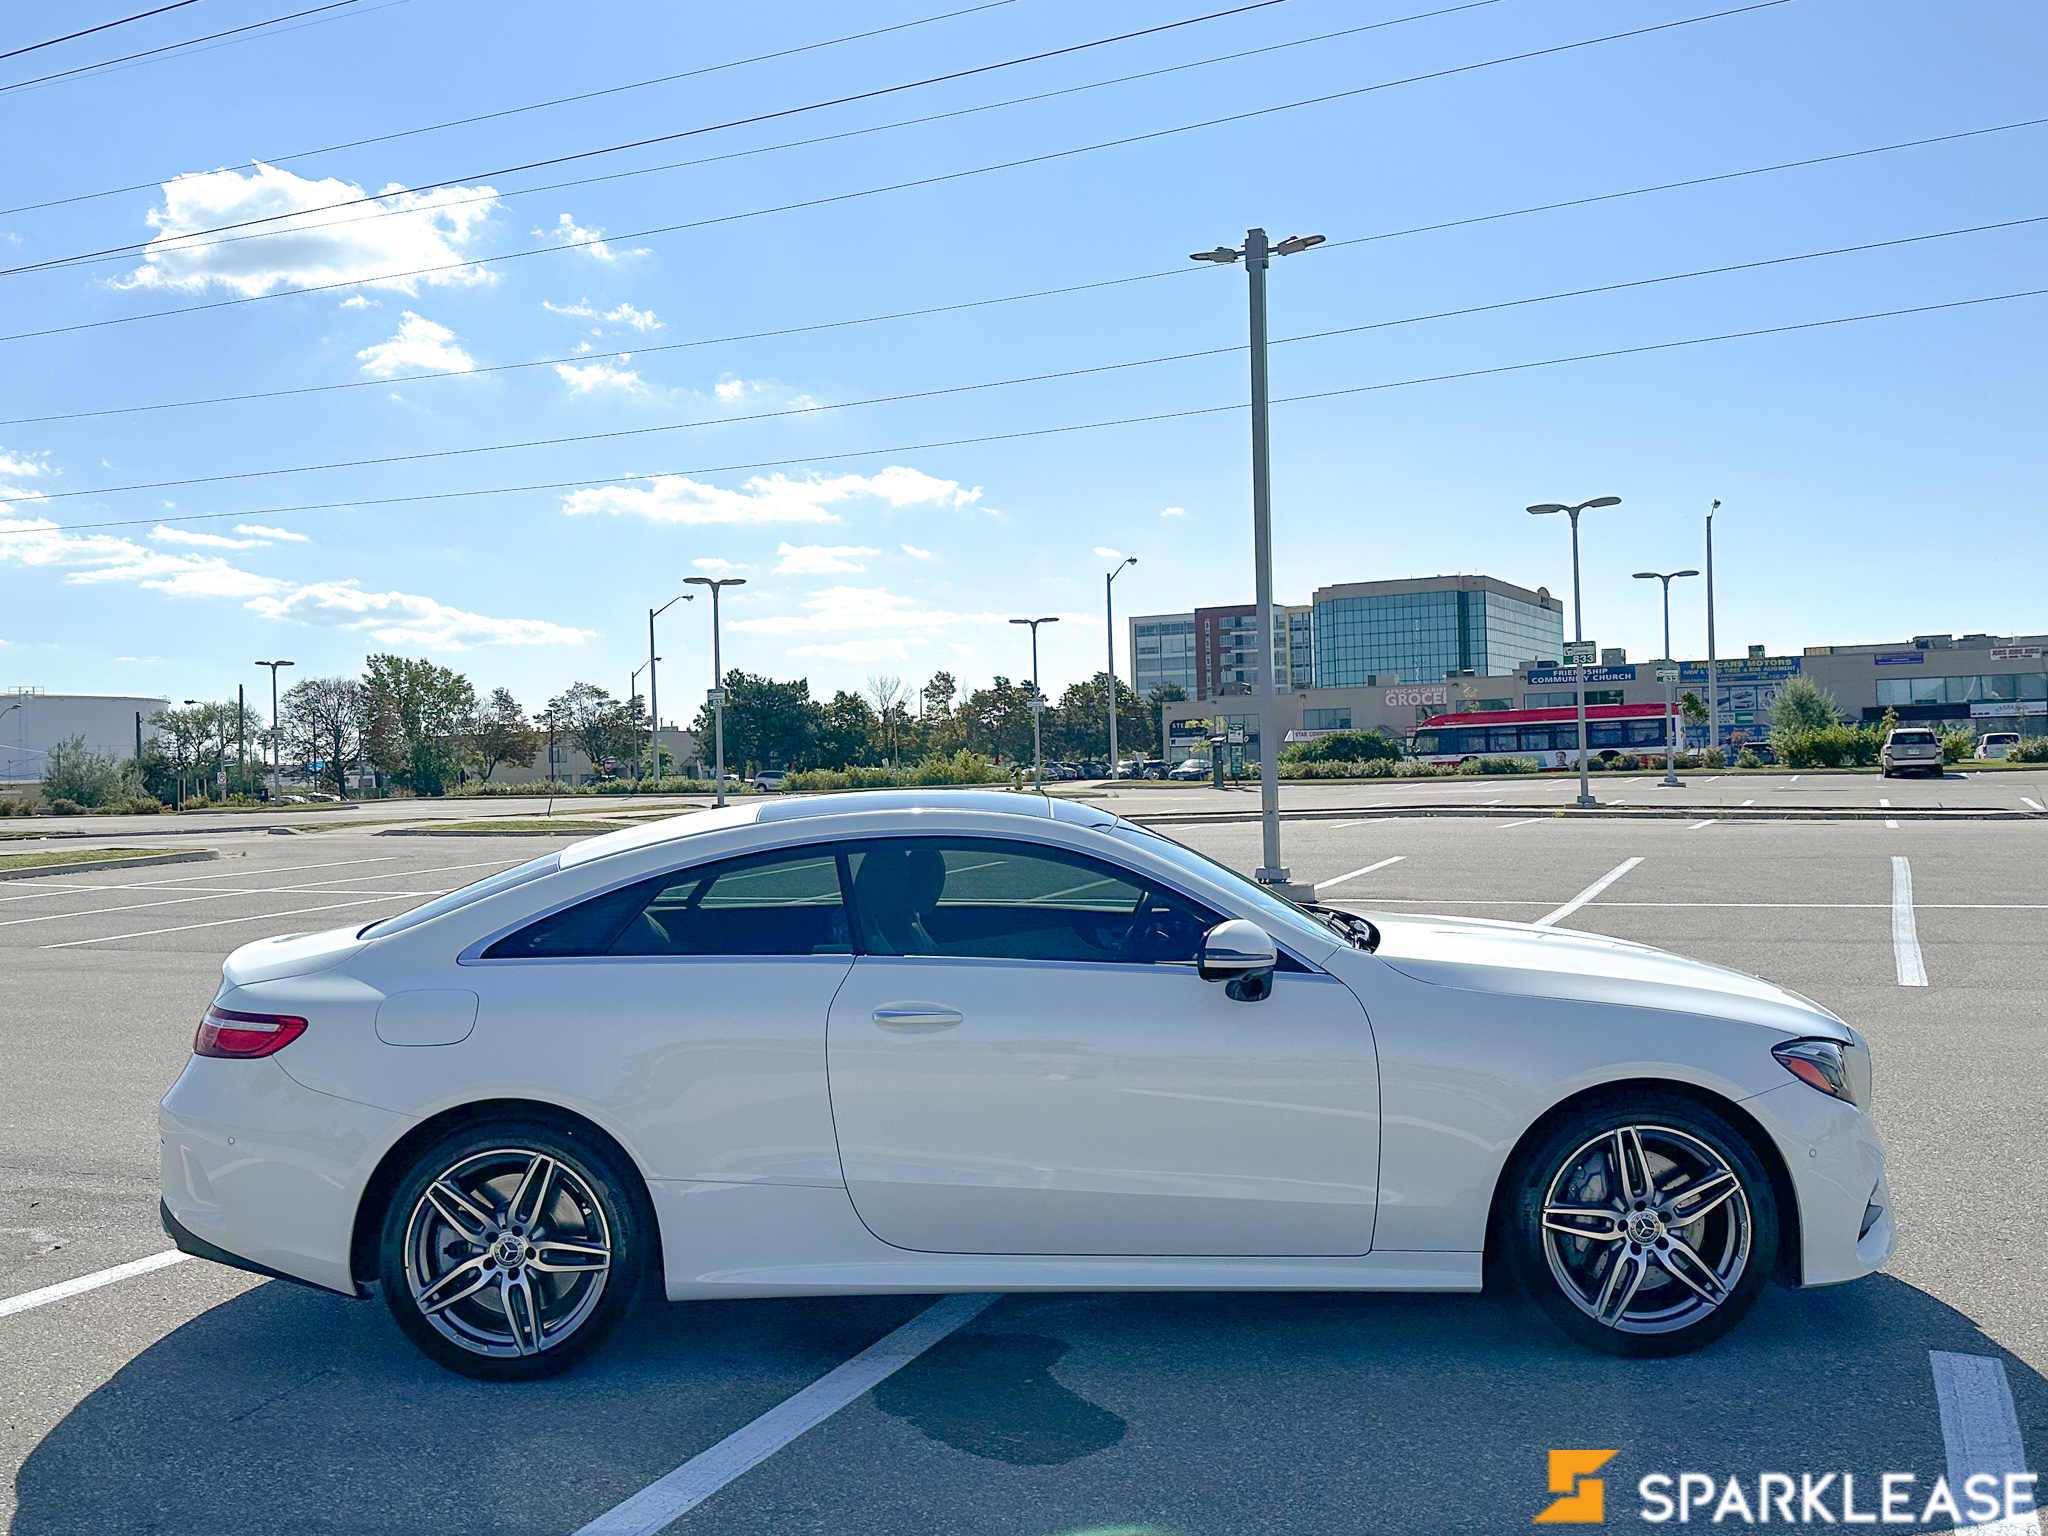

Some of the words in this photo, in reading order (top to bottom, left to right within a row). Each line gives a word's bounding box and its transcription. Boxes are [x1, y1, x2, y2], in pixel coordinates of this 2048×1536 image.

[1572, 655, 1594, 664] 833
[1748, 659, 1792, 667] MOTORS
[1592, 673, 1632, 681] CHURCH
